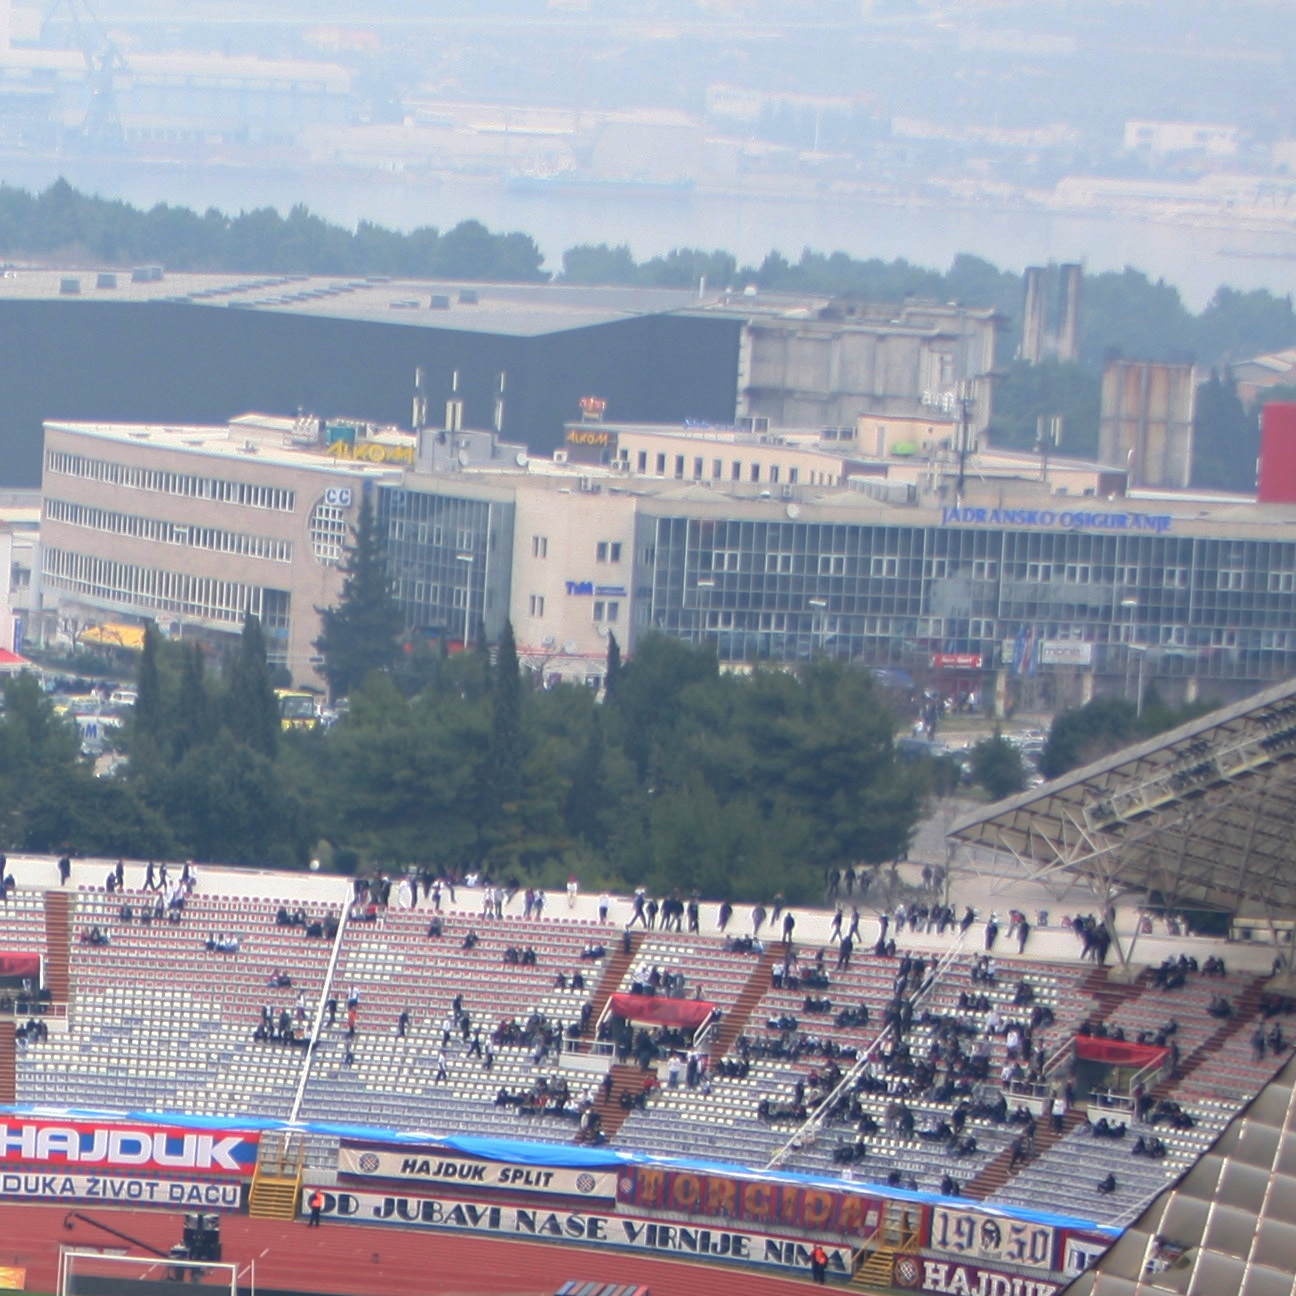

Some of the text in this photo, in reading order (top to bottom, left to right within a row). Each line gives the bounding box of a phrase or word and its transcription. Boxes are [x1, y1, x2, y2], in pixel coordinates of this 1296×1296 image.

[941, 507, 1172, 533] JADRANSKO OSIGURANJE
[400, 1159, 554, 1188] HAJDUK SPLIT
[86, 1177, 160, 1201] ŽIVOT
[637, 1169, 863, 1228] TORCIDA
[373, 1198, 501, 1229] JUBAVI
[515, 1209, 607, 1241] NAŠE
[622, 1220, 751, 1258] VIRNIJE
